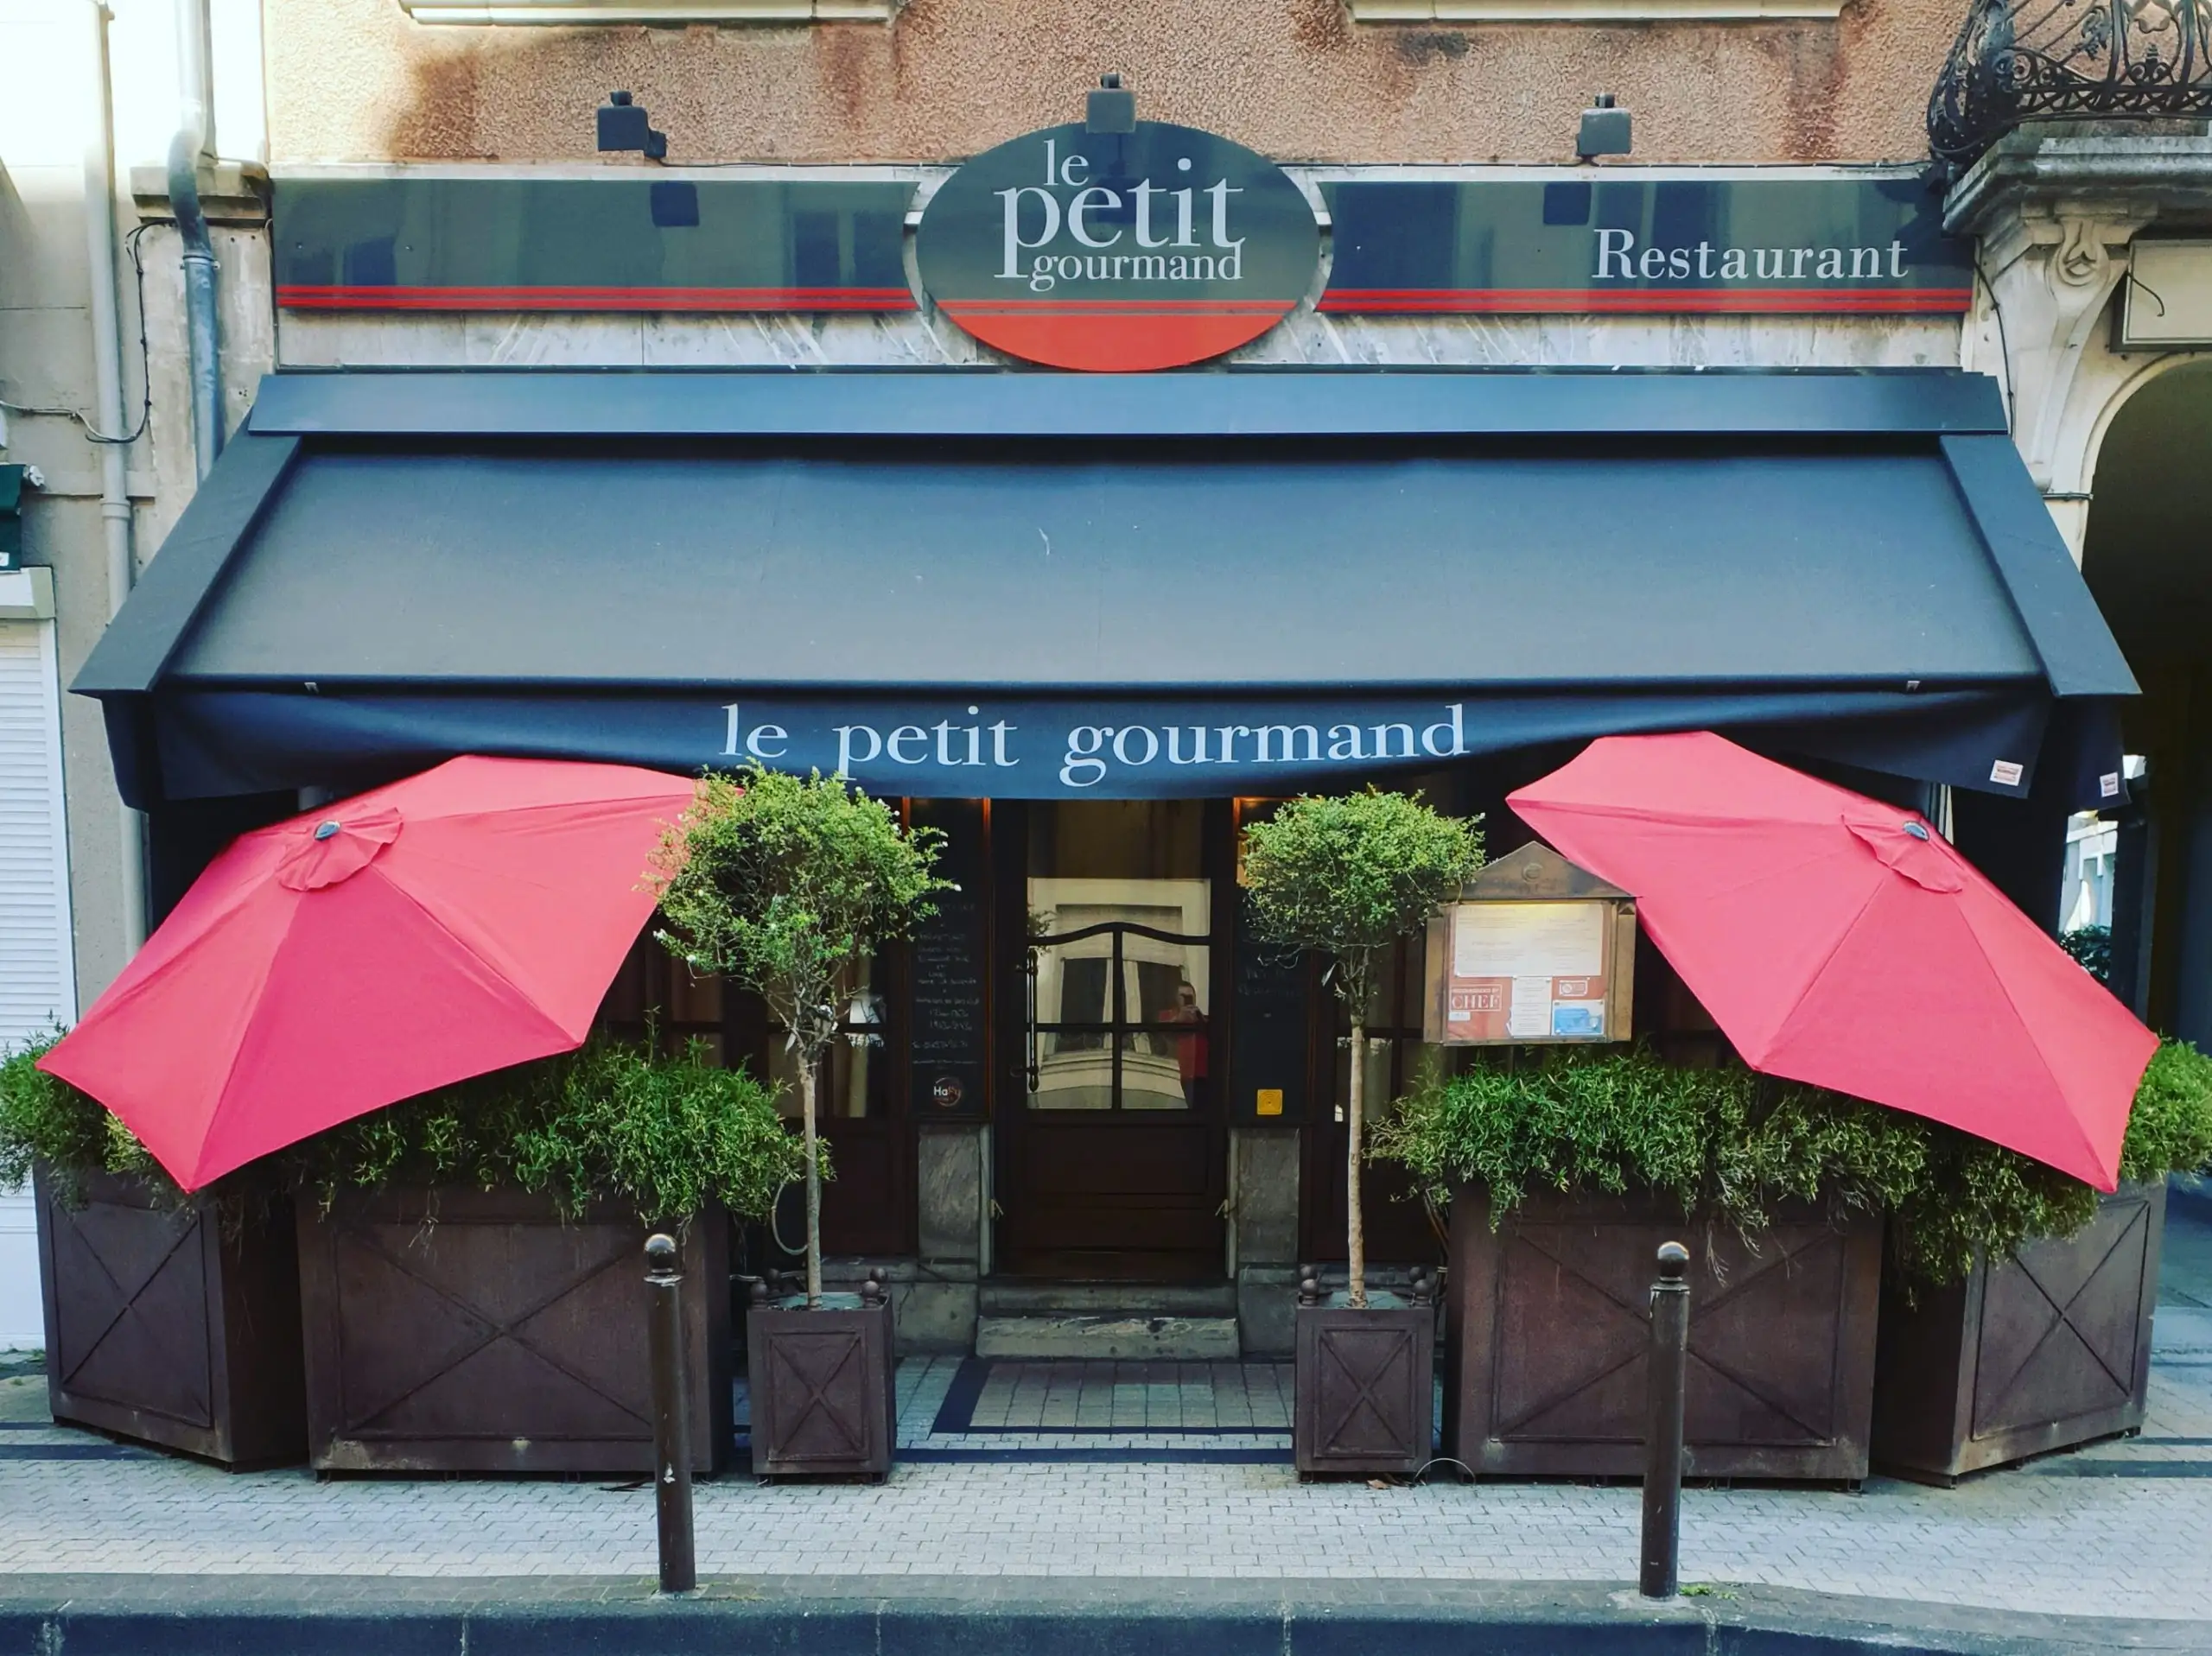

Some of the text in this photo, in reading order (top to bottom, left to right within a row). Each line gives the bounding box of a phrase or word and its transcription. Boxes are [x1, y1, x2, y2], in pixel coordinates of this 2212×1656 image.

[1043, 138, 1090, 187] le
[993, 157, 1246, 279] petit
[1029, 237, 1244, 293] gourmand
[1591, 228, 1909, 280] Restaurant
[719, 703, 1471, 788] le petit gourmand
